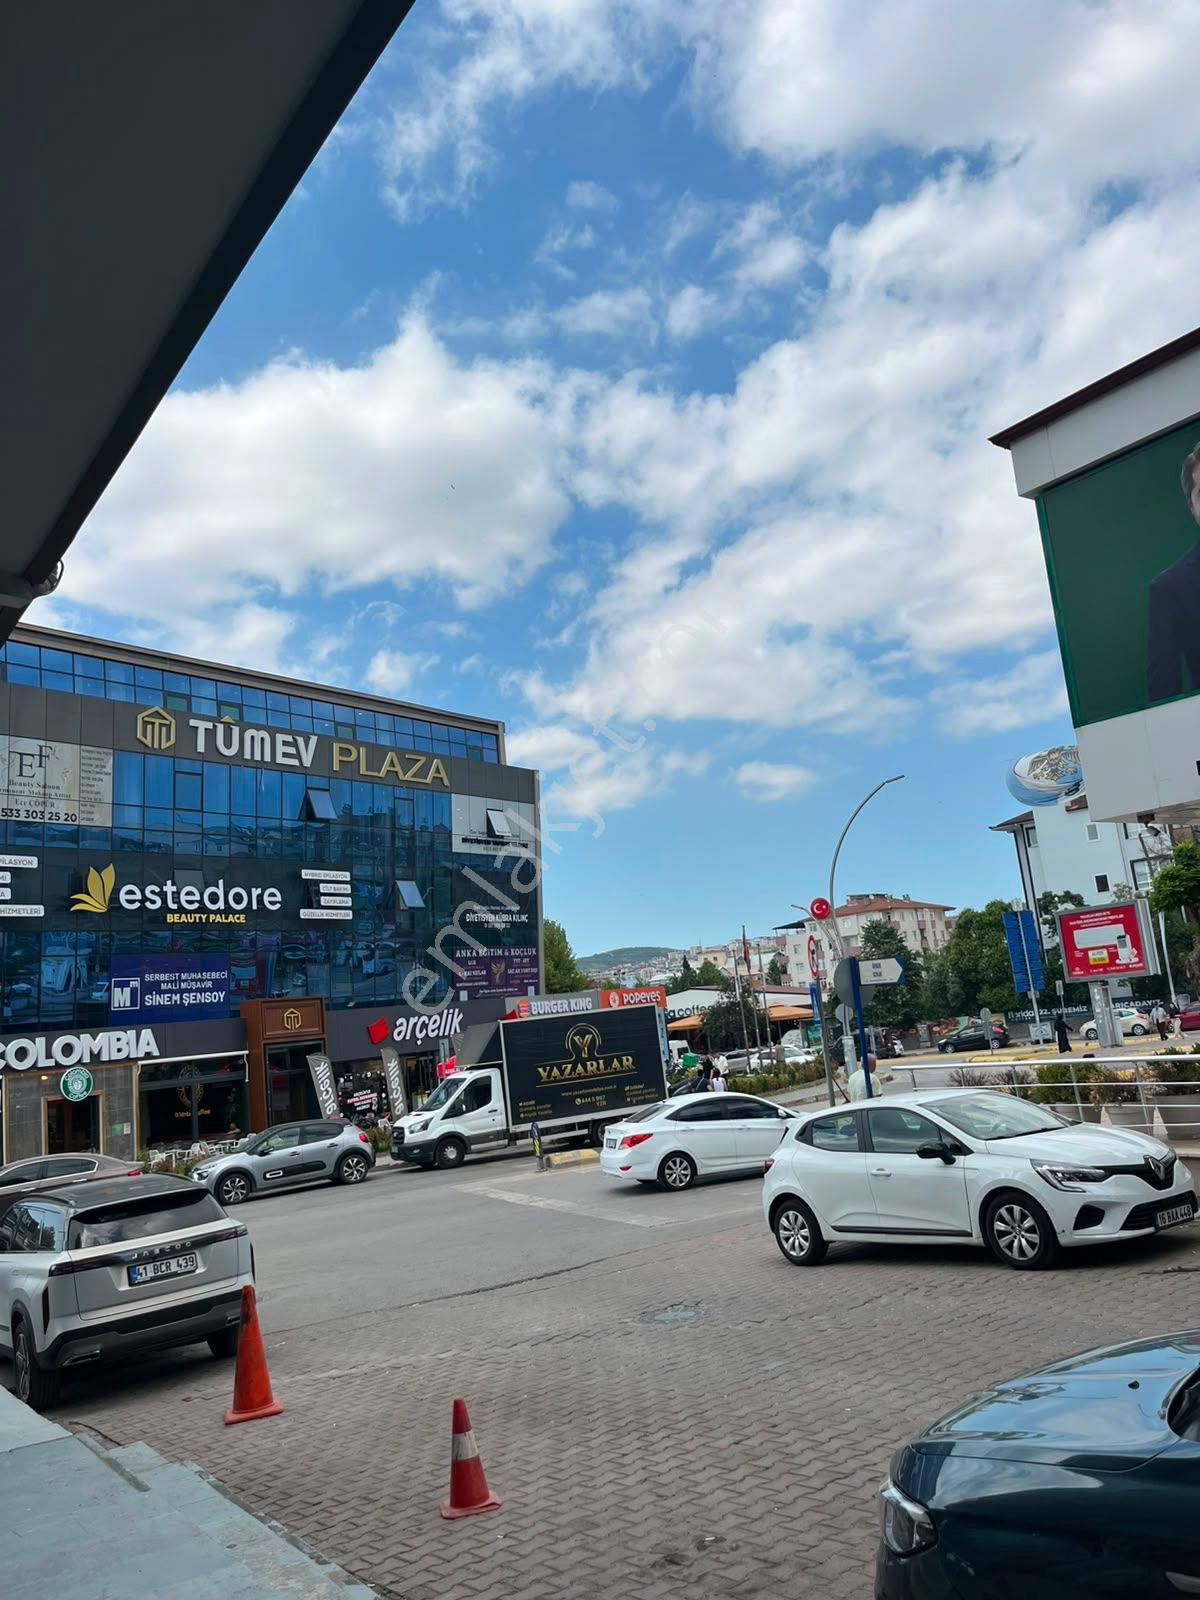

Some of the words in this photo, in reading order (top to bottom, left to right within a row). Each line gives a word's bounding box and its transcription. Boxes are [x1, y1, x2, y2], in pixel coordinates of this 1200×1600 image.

[332, 741, 450, 786] PLAZA
[1, 807, 20, 818] 533
[24, 809, 45, 820] 303
[47, 811, 60, 822] 25
[63, 813, 77, 822] 20
[119, 879, 282, 911] estedore
[167, 913, 206, 923] BEAUTY
[209, 914, 246, 923] PALACE
[456, 949, 477, 957] ANKA
[479, 947, 503, 957] EĞİTİM
[510, 947, 537, 958] KOÇLUK
[144, 973, 179, 982] SERBEST
[181, 970, 228, 980] MUHASEBECİ
[161, 981, 179, 990] MALİ
[180, 980, 213, 990] MÜŞAVİR
[144, 991, 180, 1006] SİNEM
[182, 991, 226, 1007] ŞENSOY
[530, 1001, 569, 1014] BURGER
[569, 997, 593, 1012] KING
[393, 1008, 463, 1045] arçelik
[0, 1028, 160, 1070] OLOMBIA
[536, 1055, 636, 1082] YAZARLAR
[137, 1266, 148, 1278] 41
[153, 1261, 172, 1275] BCR
[177, 1256, 195, 1269] 439
